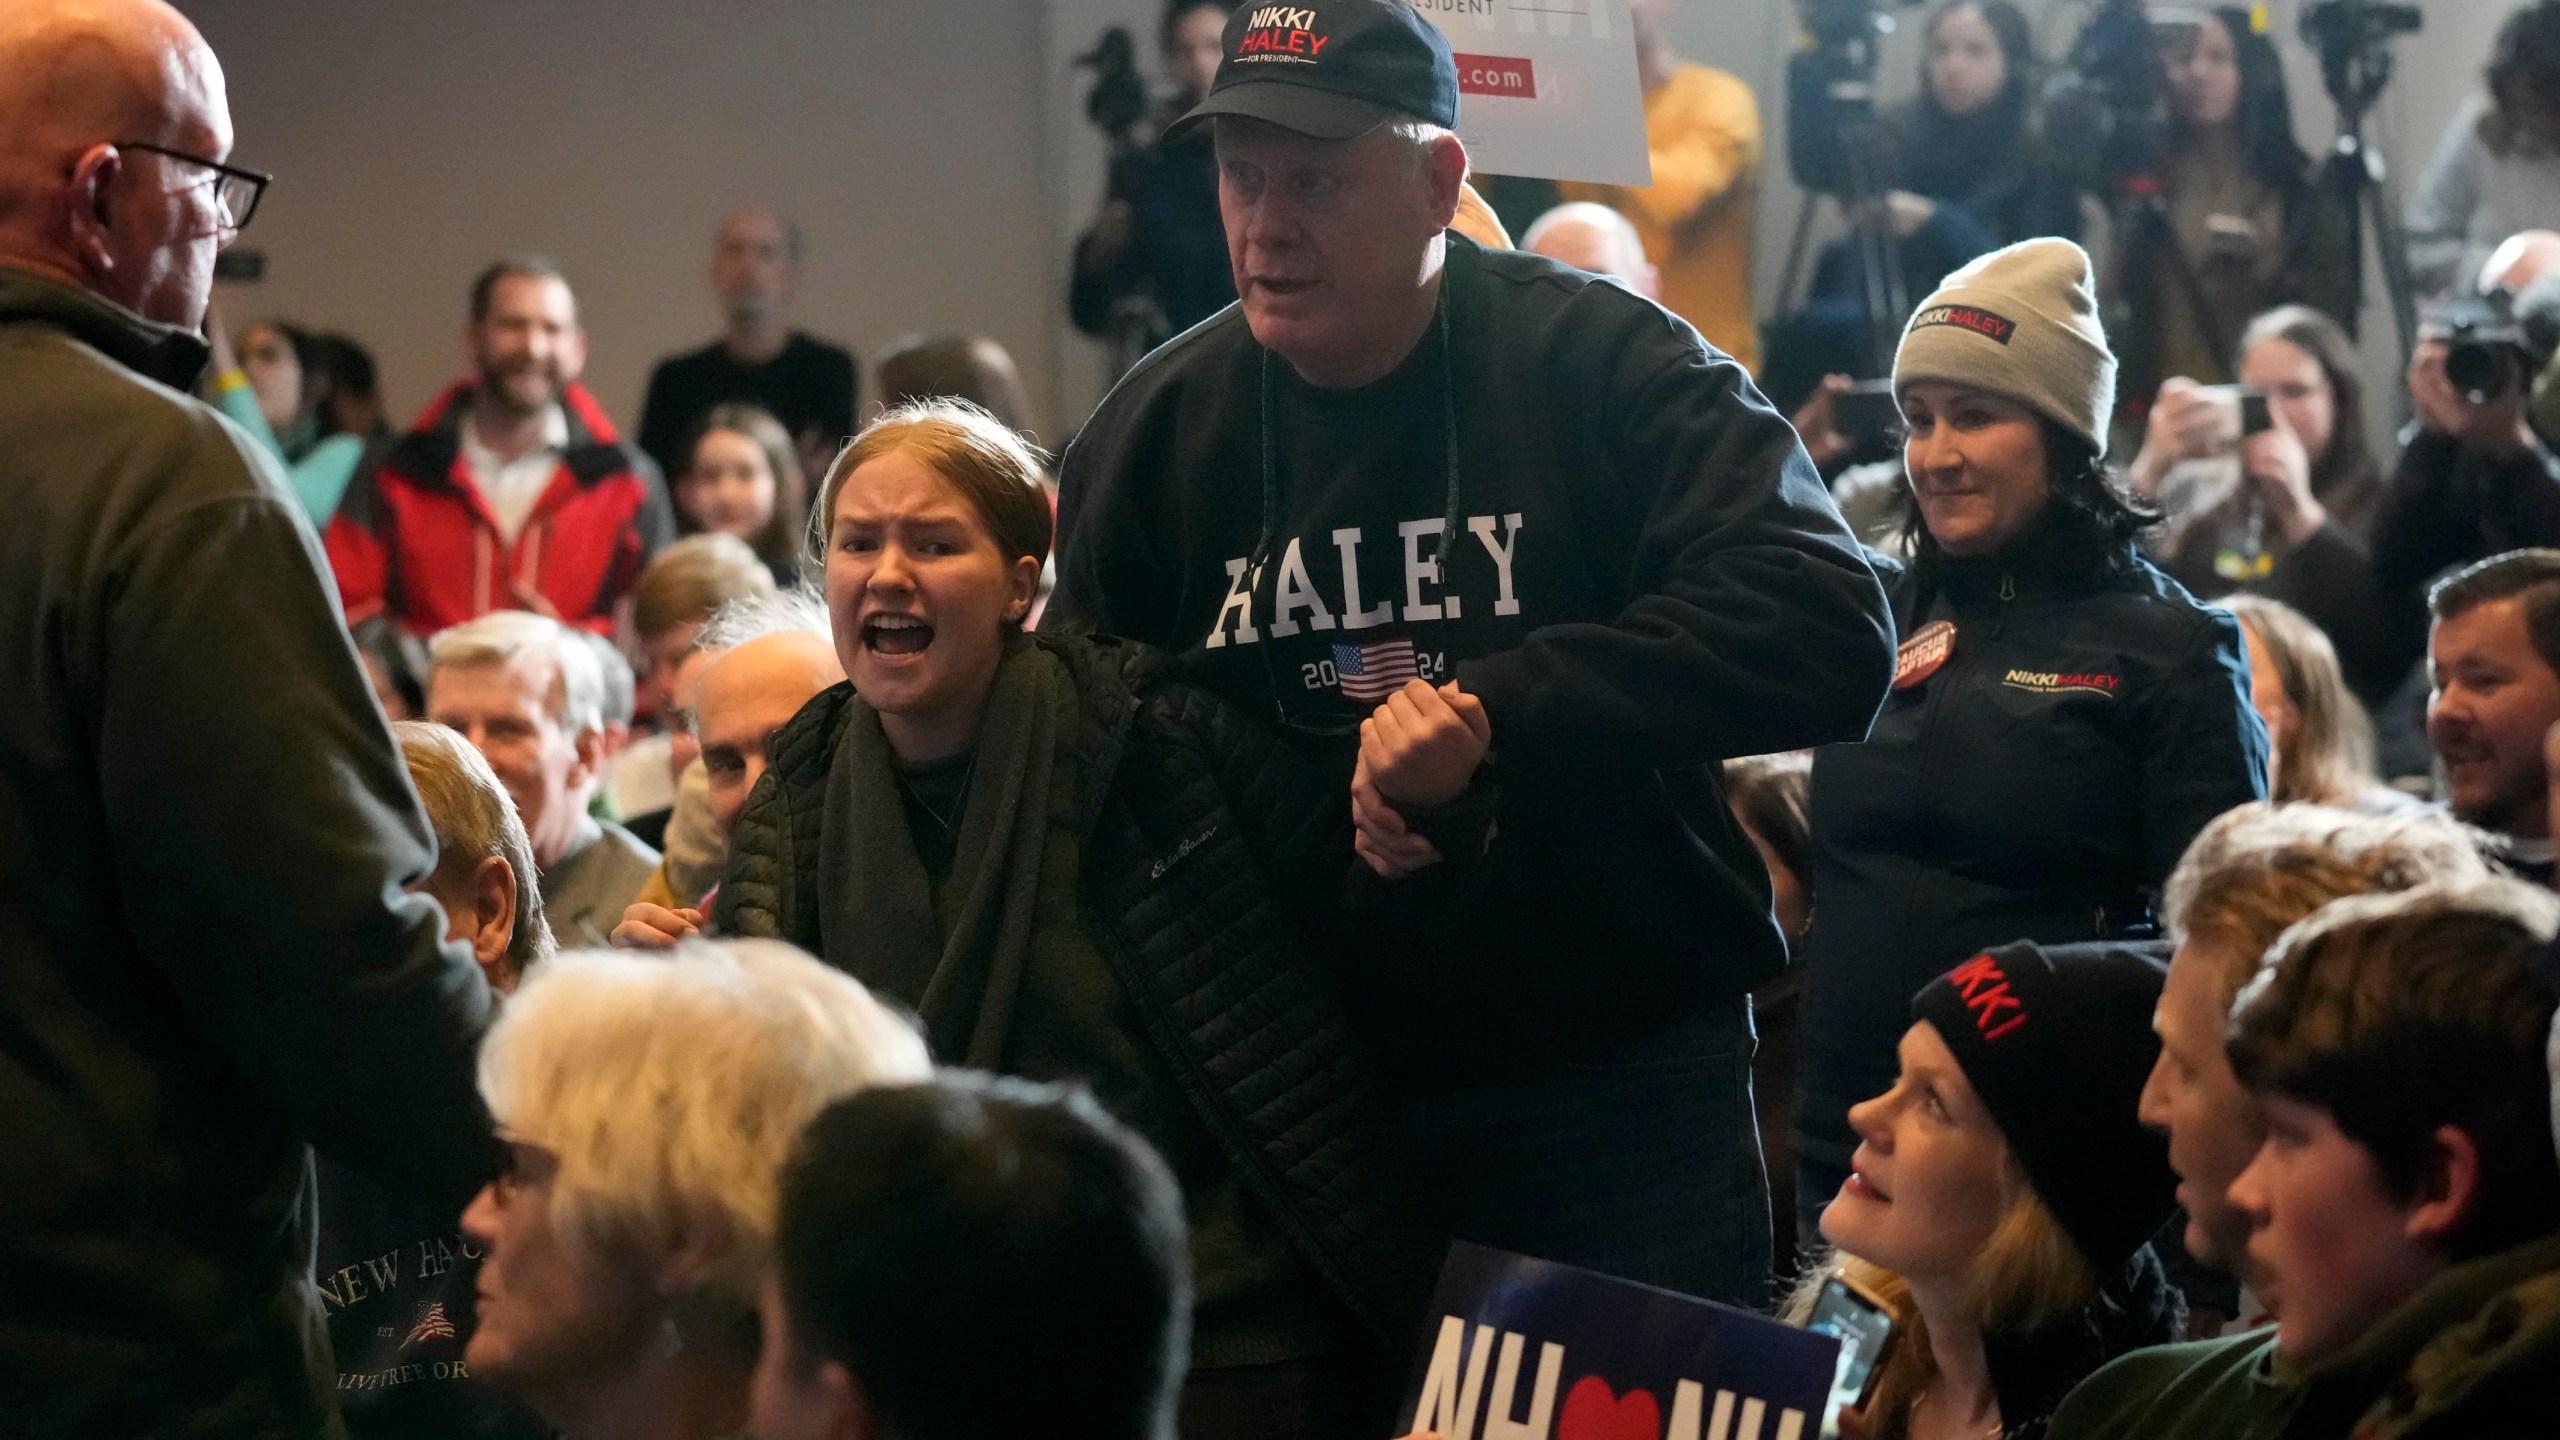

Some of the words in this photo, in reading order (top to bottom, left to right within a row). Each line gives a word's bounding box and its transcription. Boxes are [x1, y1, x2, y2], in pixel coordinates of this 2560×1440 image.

[1247, 7, 1317, 32] NIKKI
[1239, 28, 1329, 55] HALEY
[1247, 54, 1259, 62] FOR
[1260, 54, 1299, 63] PRESIDENT
[1455, 66, 1522, 88] .com
[1206, 513, 1523, 649] HALEY
[1895, 645, 1948, 681] APTAIN
[1897, 630, 1949, 669] AUCUS
[1949, 954, 2027, 1041] IKKI
[316, 1248, 399, 1316] NEW
[433, 1361, 470, 1380] OR
